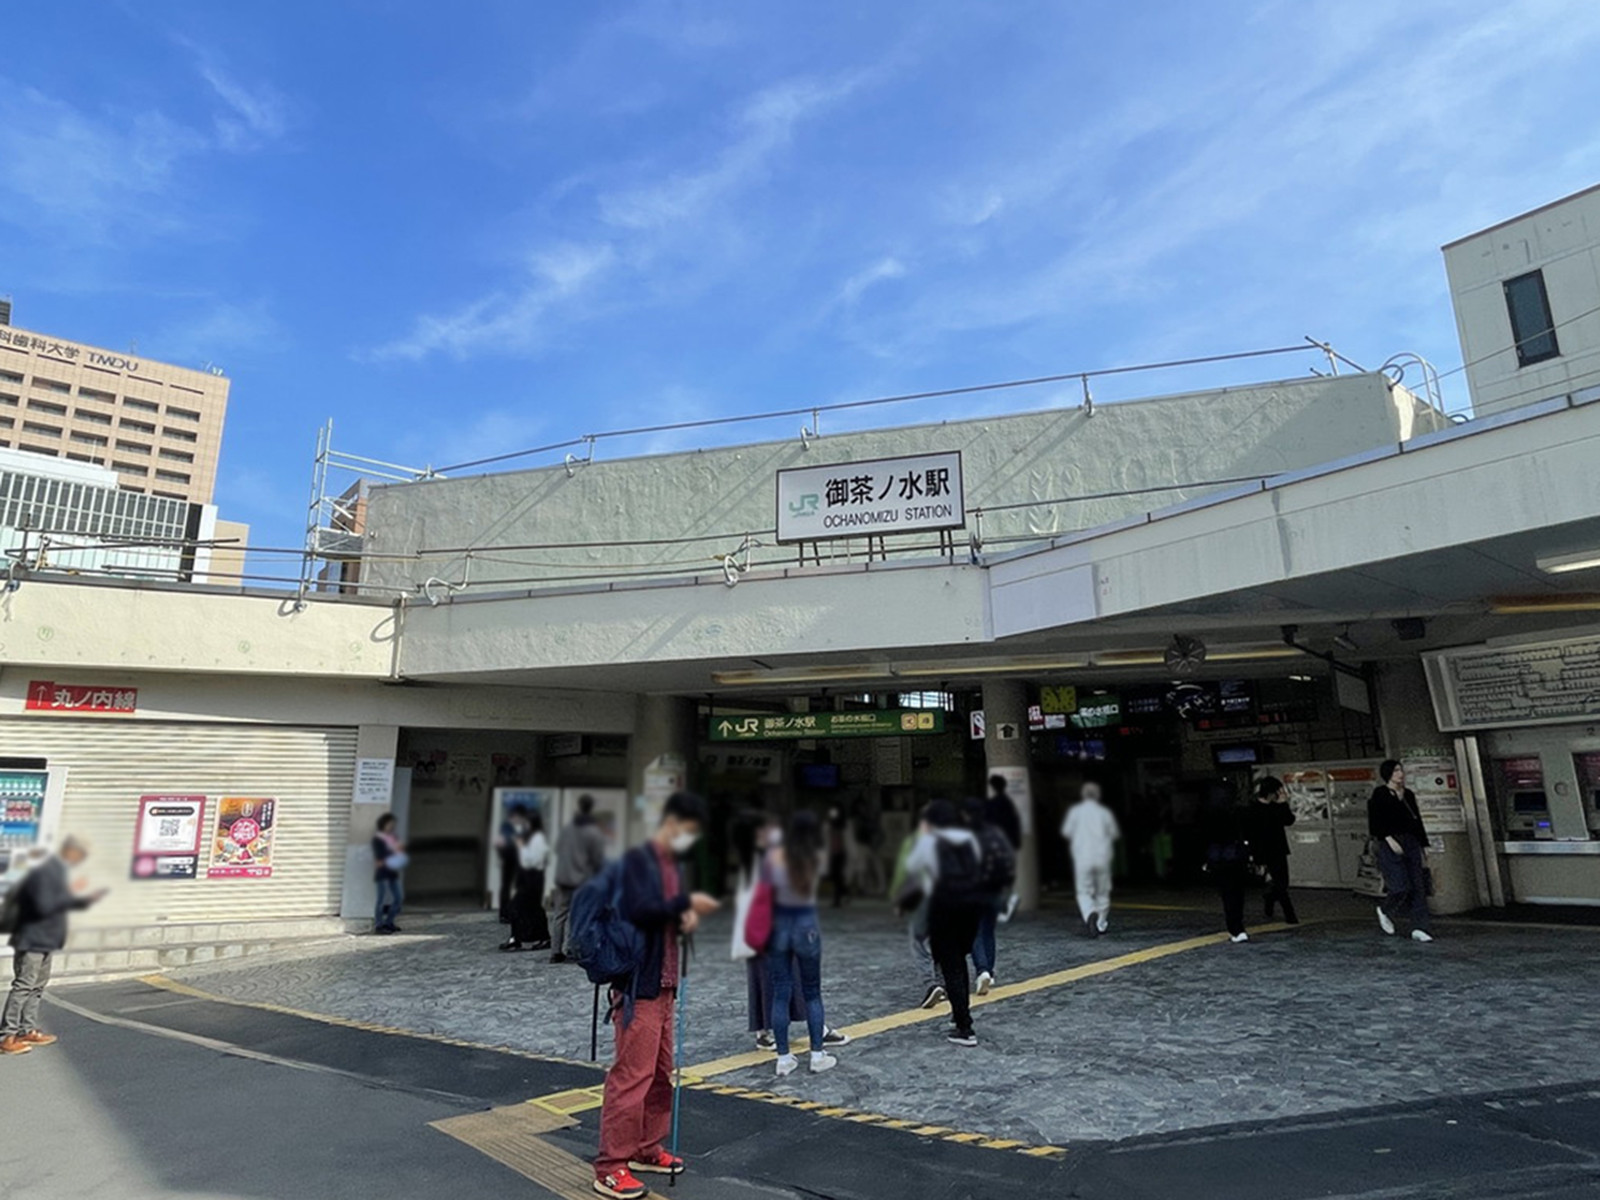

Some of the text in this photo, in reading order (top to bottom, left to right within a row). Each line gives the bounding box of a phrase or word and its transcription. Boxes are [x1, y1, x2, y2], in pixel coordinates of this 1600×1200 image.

[88, 352, 139, 372] TMDU
[824, 468, 951, 508] 御茶ノ水駅
[788, 493, 820, 513] JR
[823, 509, 899, 529] OCHANOMIZU
[904, 504, 952, 521] STATION
[51, 689, 135, 710] 丸ノ内線
[735, 717, 759, 733] JR
[764, 715, 816, 729] 御茶ノ水駅
